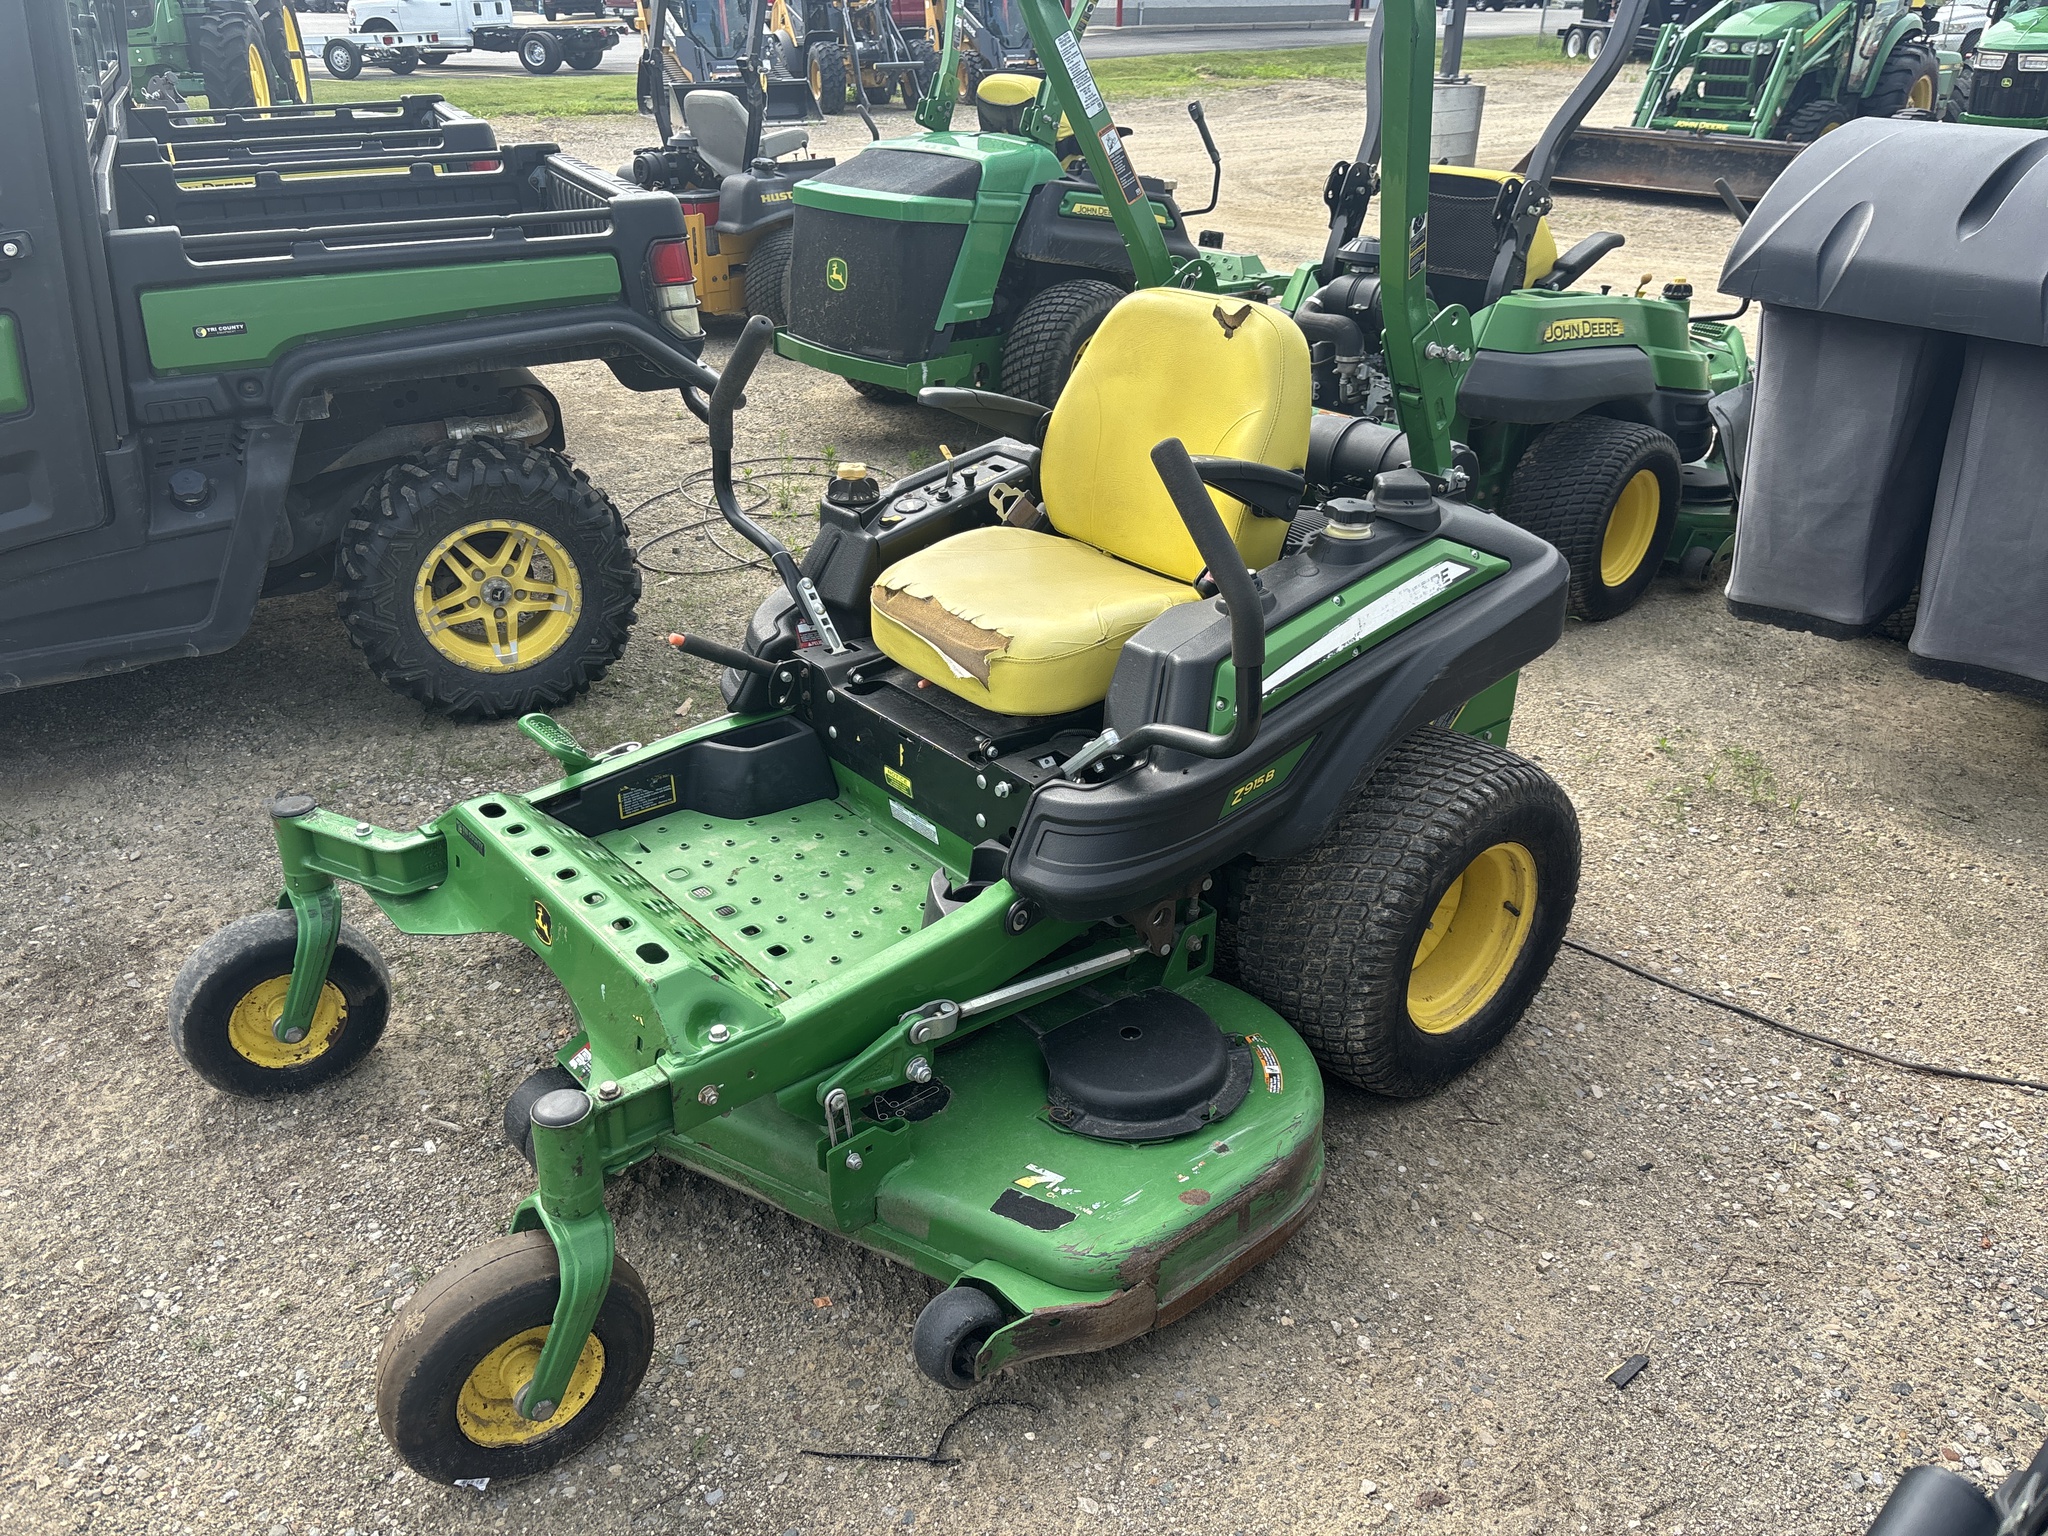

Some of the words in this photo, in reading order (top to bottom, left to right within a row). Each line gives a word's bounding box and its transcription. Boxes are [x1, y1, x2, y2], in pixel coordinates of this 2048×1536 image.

[1674, 120, 1699, 128] JOHN
[1699, 121, 1728, 131] DEERE
[1078, 205, 1098, 215] JOHN
[1546, 322, 1580, 340] JOHN
[1582, 320, 1619, 336] DEERE
[1231, 769, 1275, 806] Z915B
